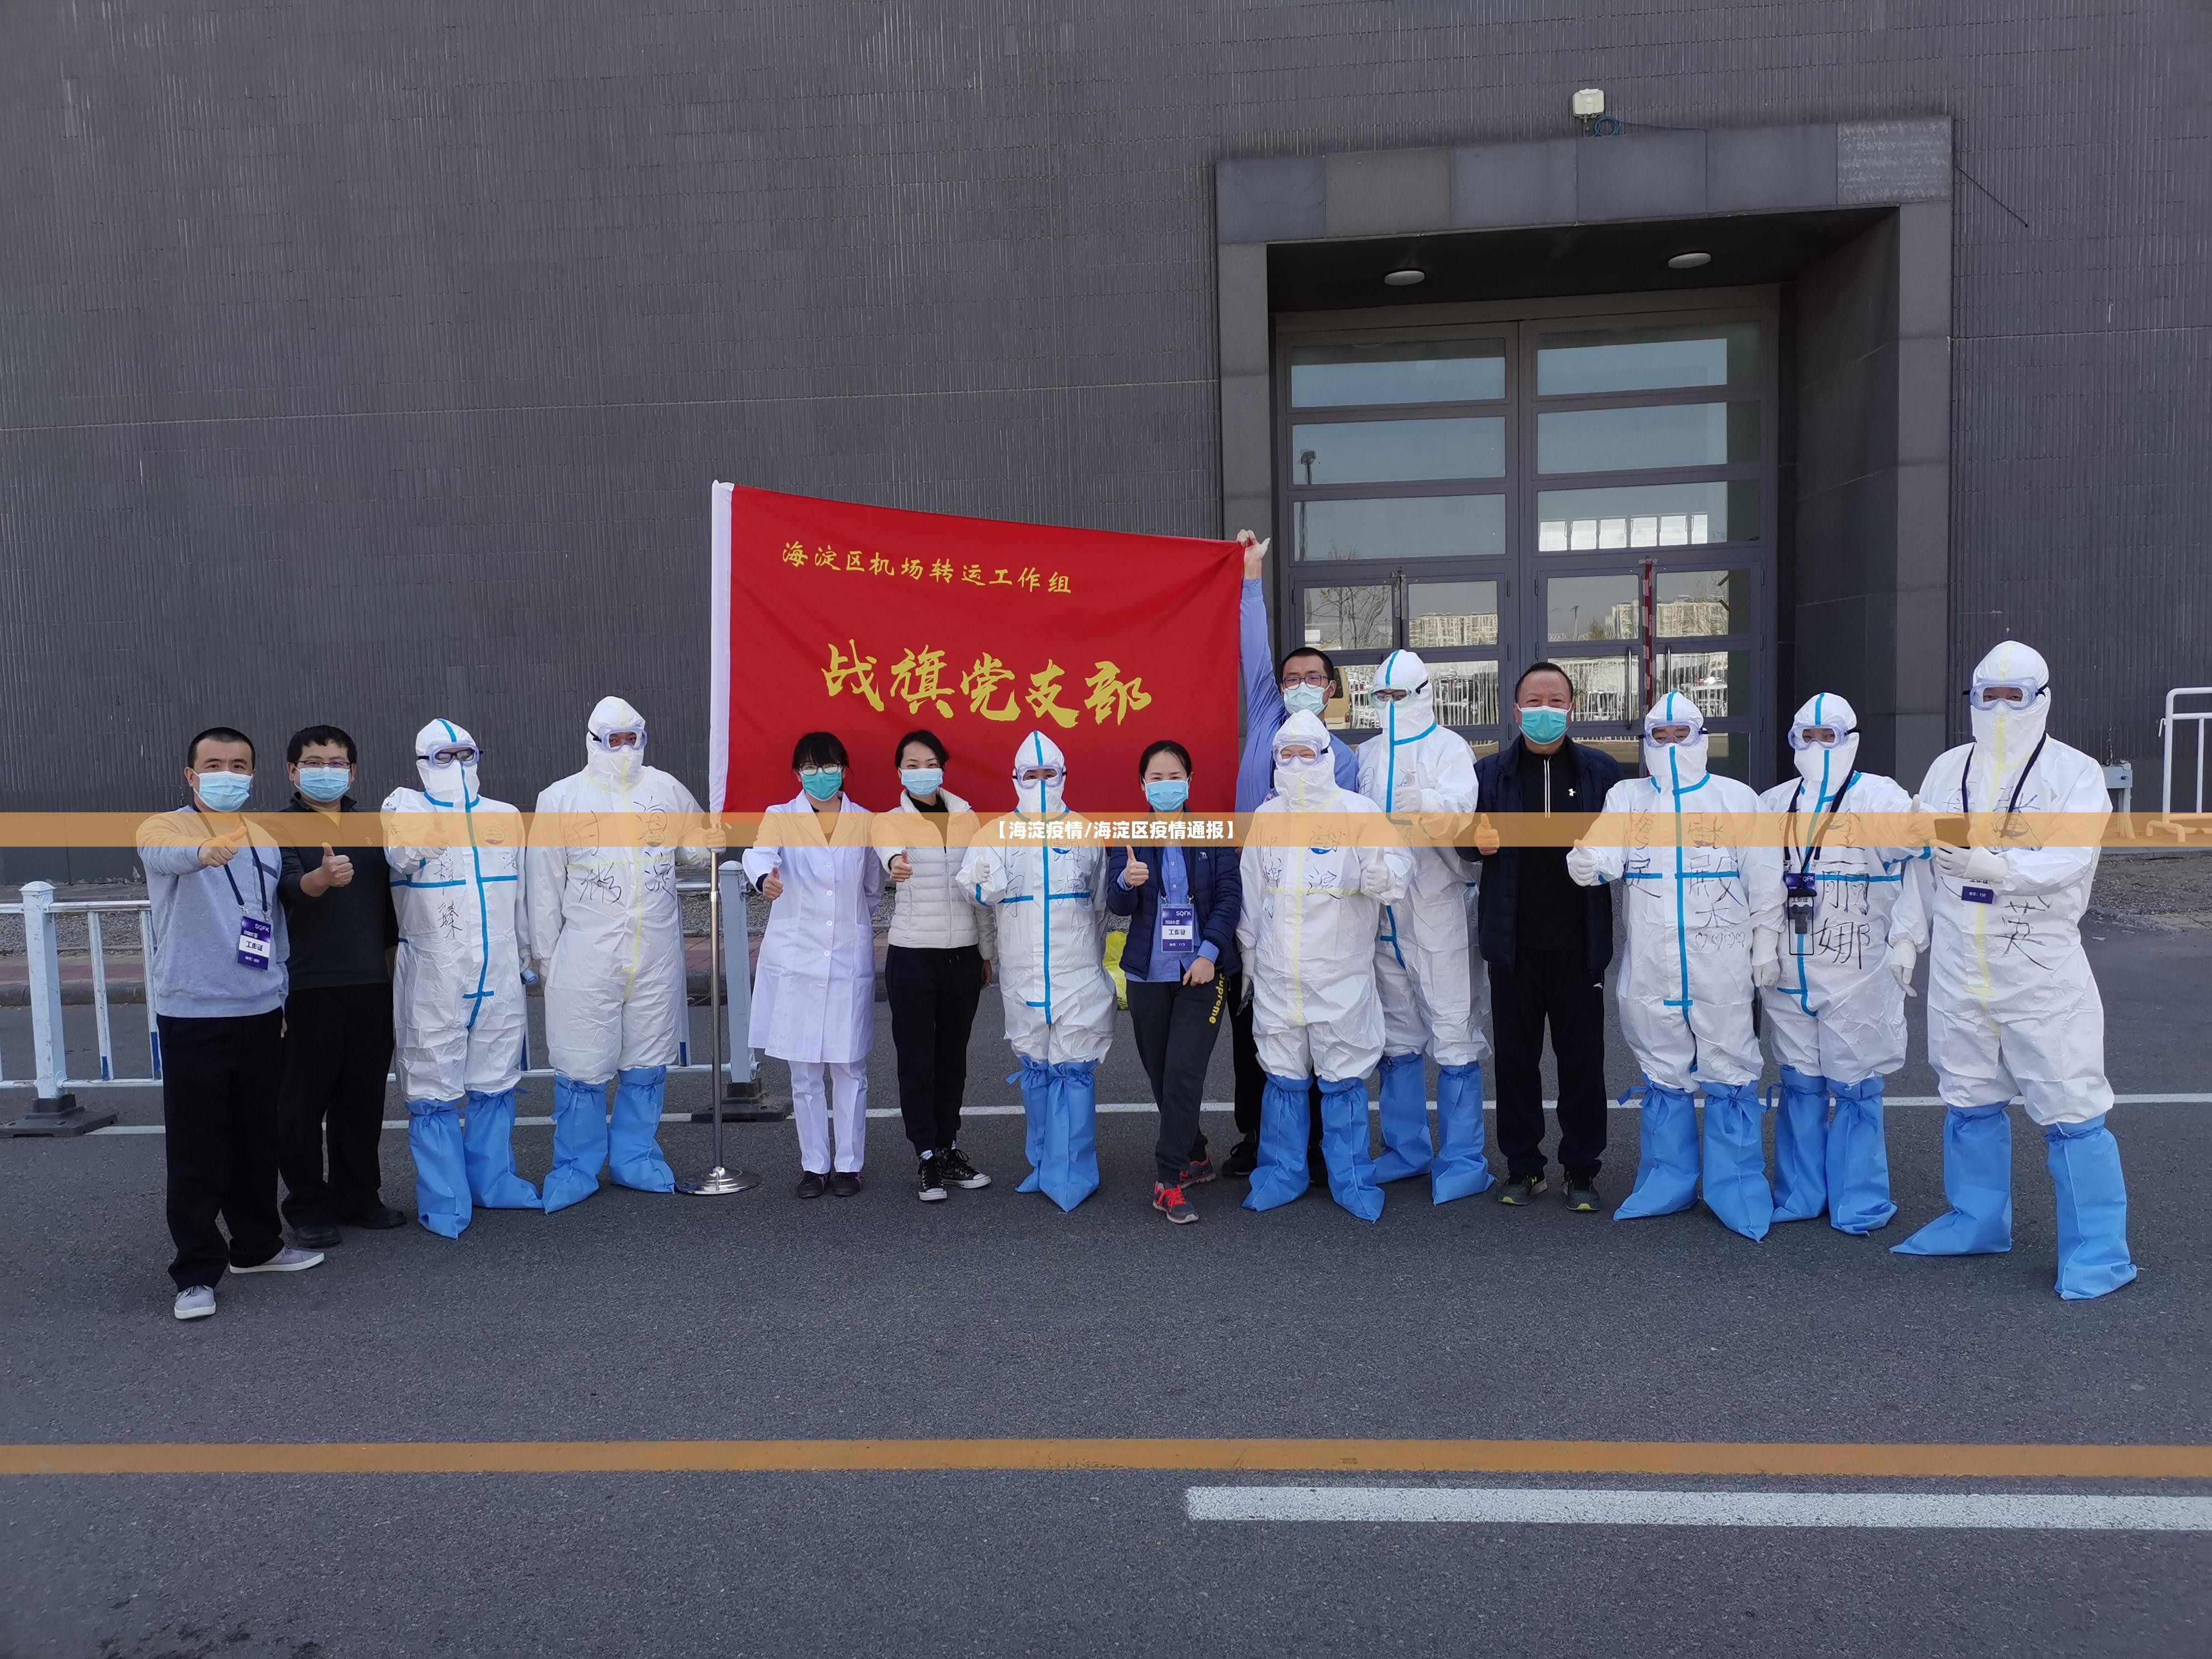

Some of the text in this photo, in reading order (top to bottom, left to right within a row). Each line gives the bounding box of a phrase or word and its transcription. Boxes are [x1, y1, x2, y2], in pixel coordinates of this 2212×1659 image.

[782, 541, 1071, 593] 海淀区机场转运工作组
[821, 639, 1152, 728] 战旗党支部
